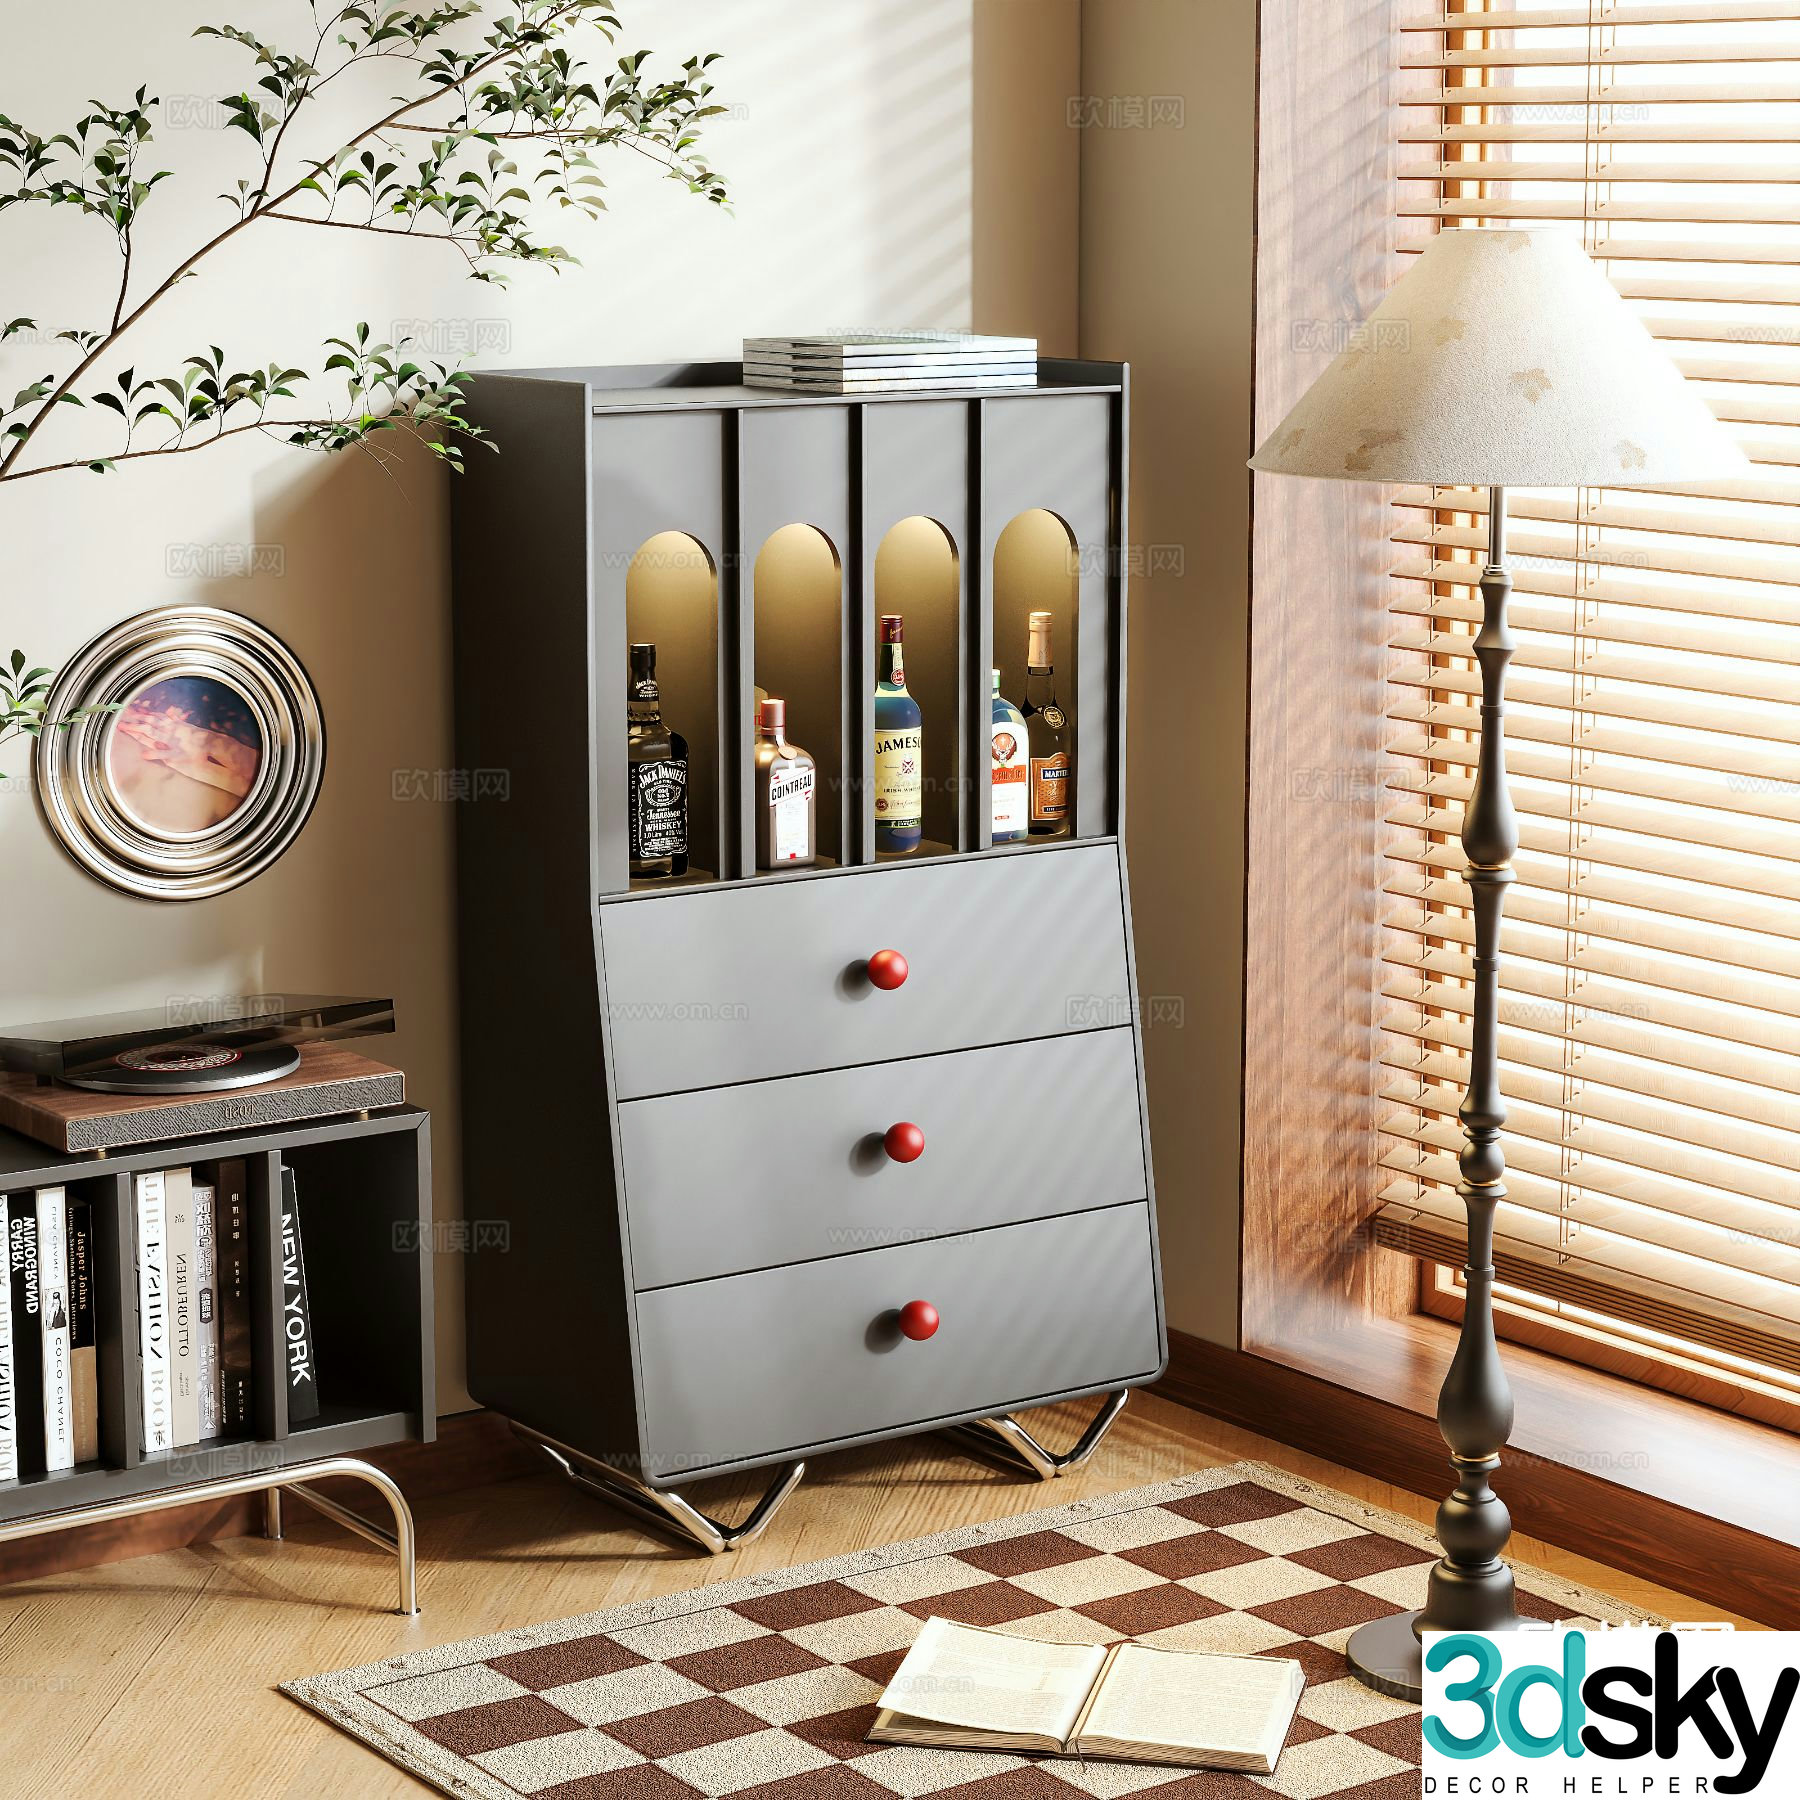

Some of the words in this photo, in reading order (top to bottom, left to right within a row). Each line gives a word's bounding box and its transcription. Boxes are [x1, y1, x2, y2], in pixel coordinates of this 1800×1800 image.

[639, 768, 658, 789] JACK
[771, 773, 813, 801] COINTREAU
[645, 820, 682, 832] WHISKEY
[76, 1231, 86, 1271] Jasper
[281, 1212, 300, 1286] NEW
[78, 1274, 88, 1311] Johns
[284, 1292, 312, 1388] YORK
